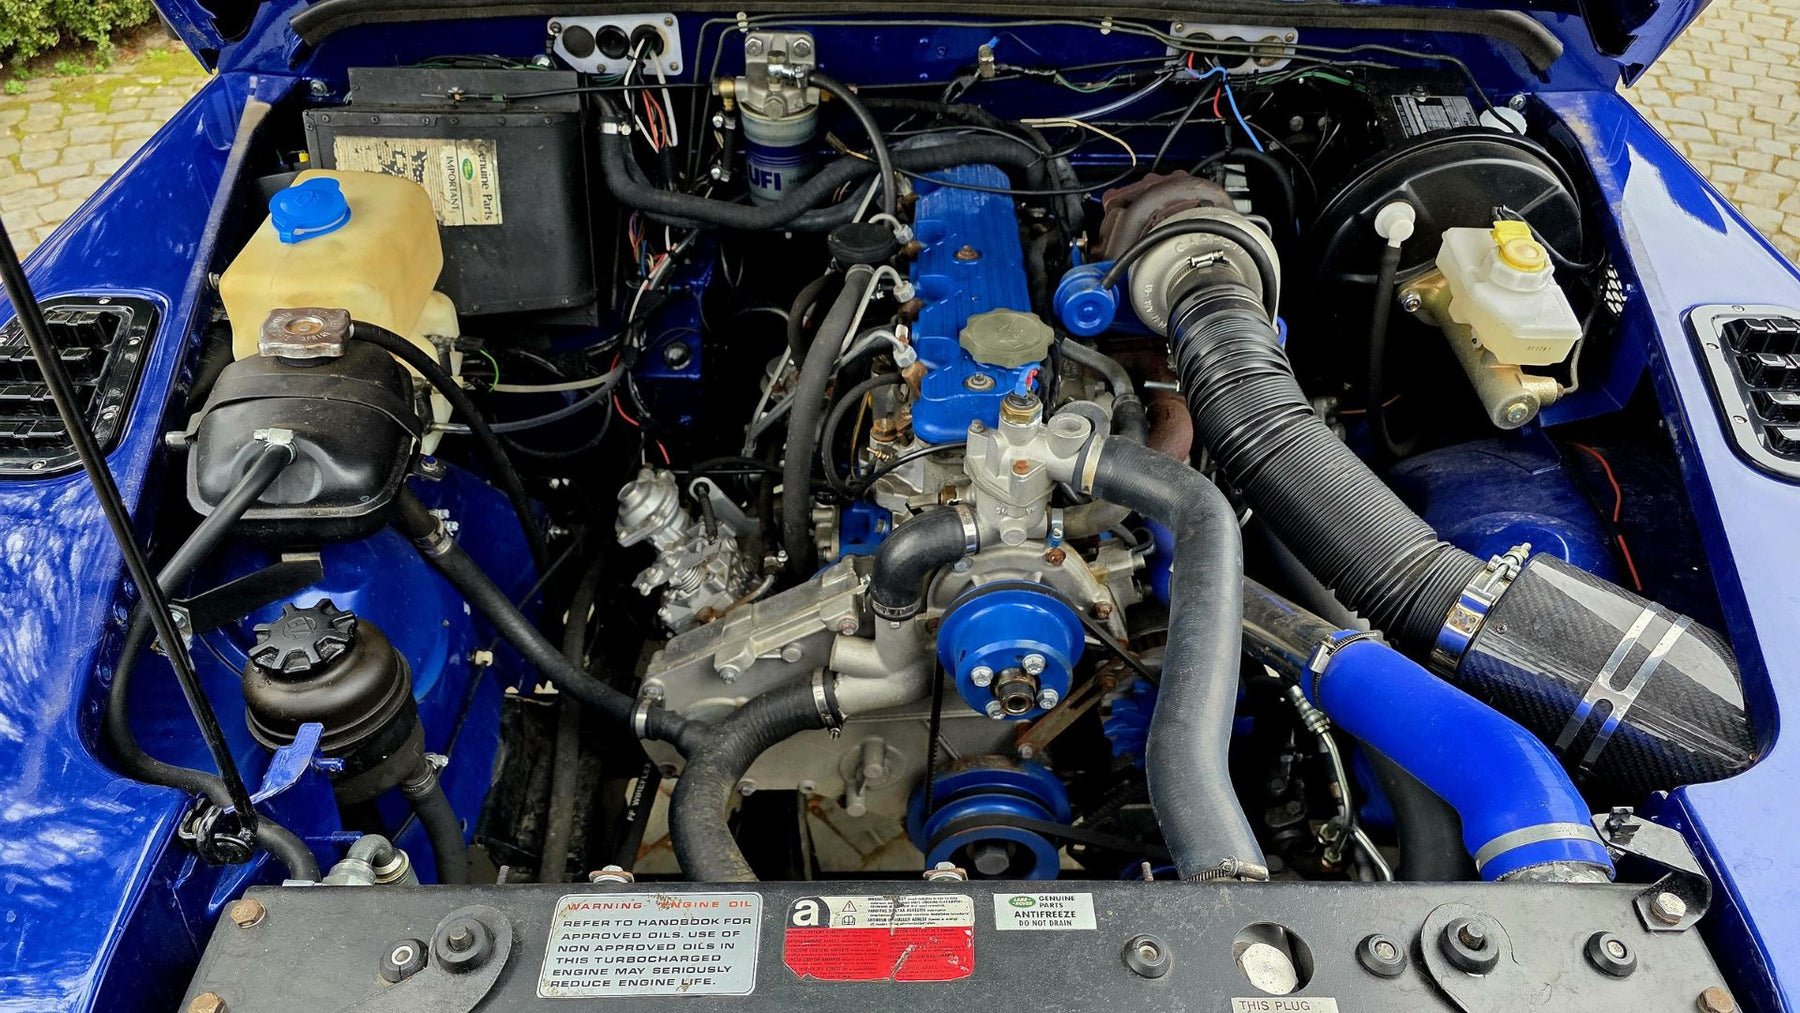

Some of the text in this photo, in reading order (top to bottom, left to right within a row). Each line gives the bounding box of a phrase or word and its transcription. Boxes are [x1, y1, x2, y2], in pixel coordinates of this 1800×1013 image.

[748, 164, 782, 191] UFI
[446, 156, 459, 211] IMPORTANT
[482, 193, 492, 221] Parts
[567, 902, 642, 911] WARNING
[728, 900, 752, 908] OIL
[792, 899, 819, 927] a
[1014, 911, 1077, 919] ANTIFREEZE
[563, 917, 752, 928] REFER TO HANDBOOK FOR
[561, 930, 741, 941] APPROVED OILS. USE OF
[557, 942, 735, 953] NON APPROVED OILS IN
[556, 954, 721, 965] THIS TURBOCHARGED
[552, 965, 732, 977] ENGINE MAY SERIOUSLY
[550, 977, 716, 988] REDUCE ENGINE LIFE.
[1239, 1000, 1310, 1011] THIS PLUG
